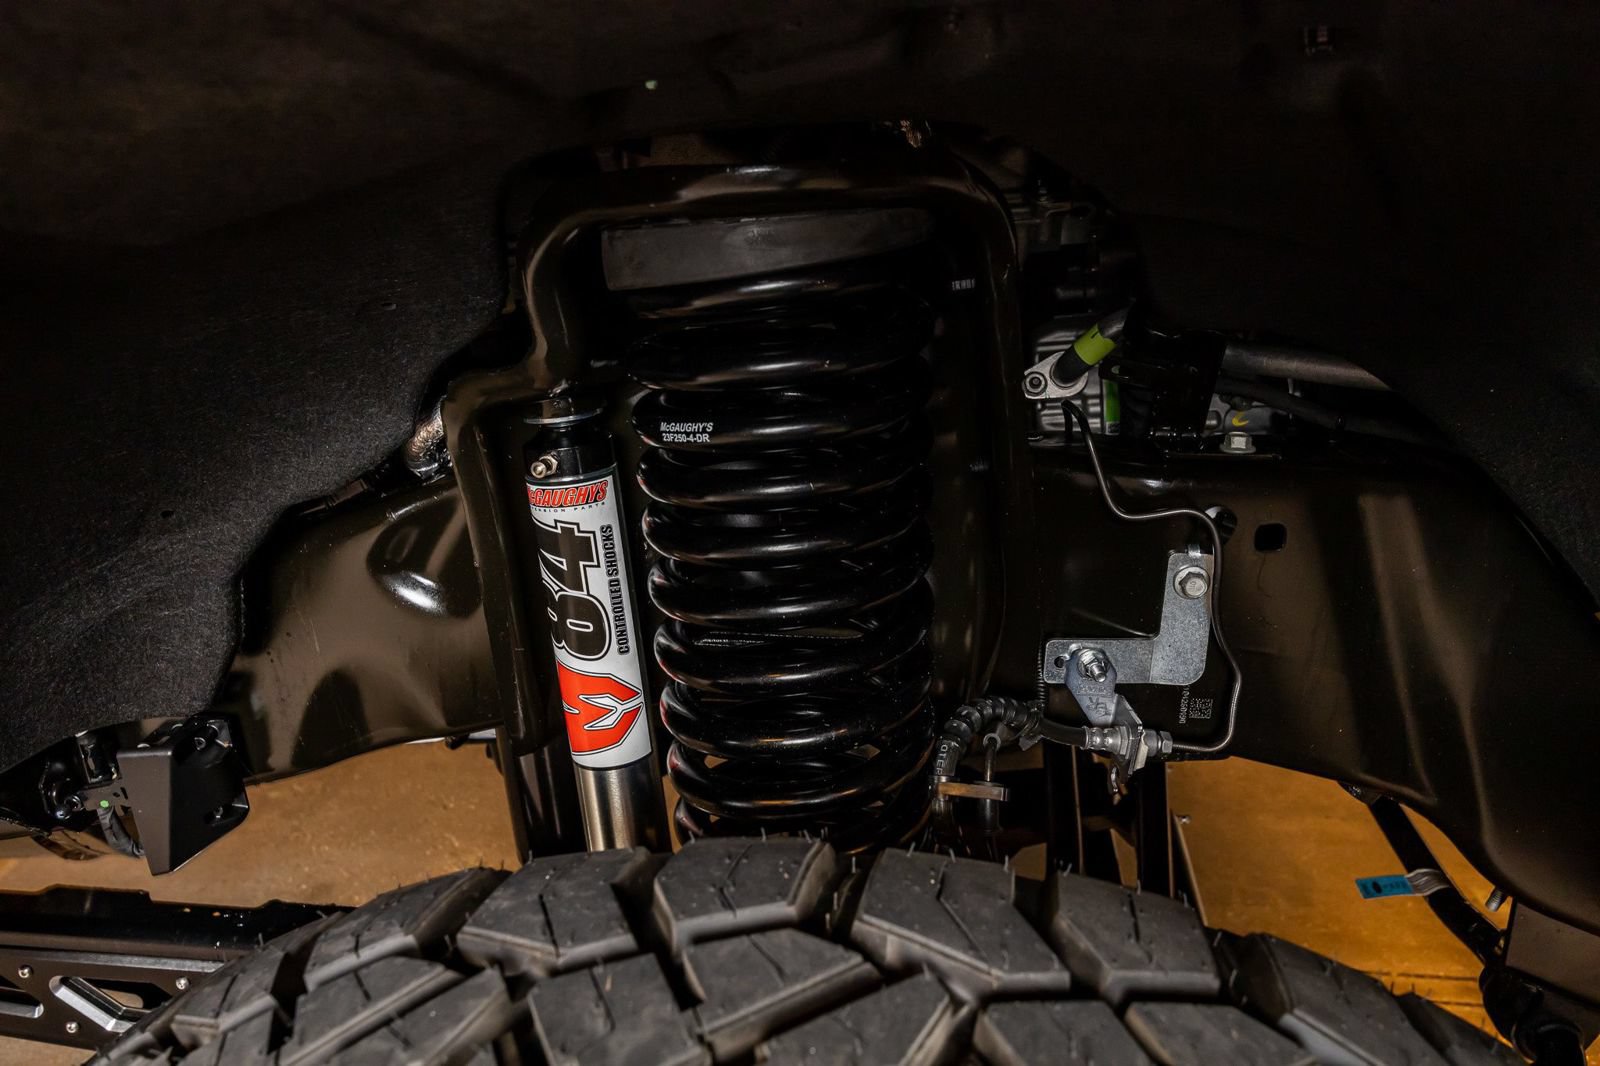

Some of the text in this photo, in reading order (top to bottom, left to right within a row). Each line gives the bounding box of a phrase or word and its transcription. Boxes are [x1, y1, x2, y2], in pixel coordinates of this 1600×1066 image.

[660, 422, 713, 432] McGAUGHY'S
[662, 433, 711, 443] 23F250-4-DR
[600, 523, 631, 655] CONTROLLED SHOCKS
